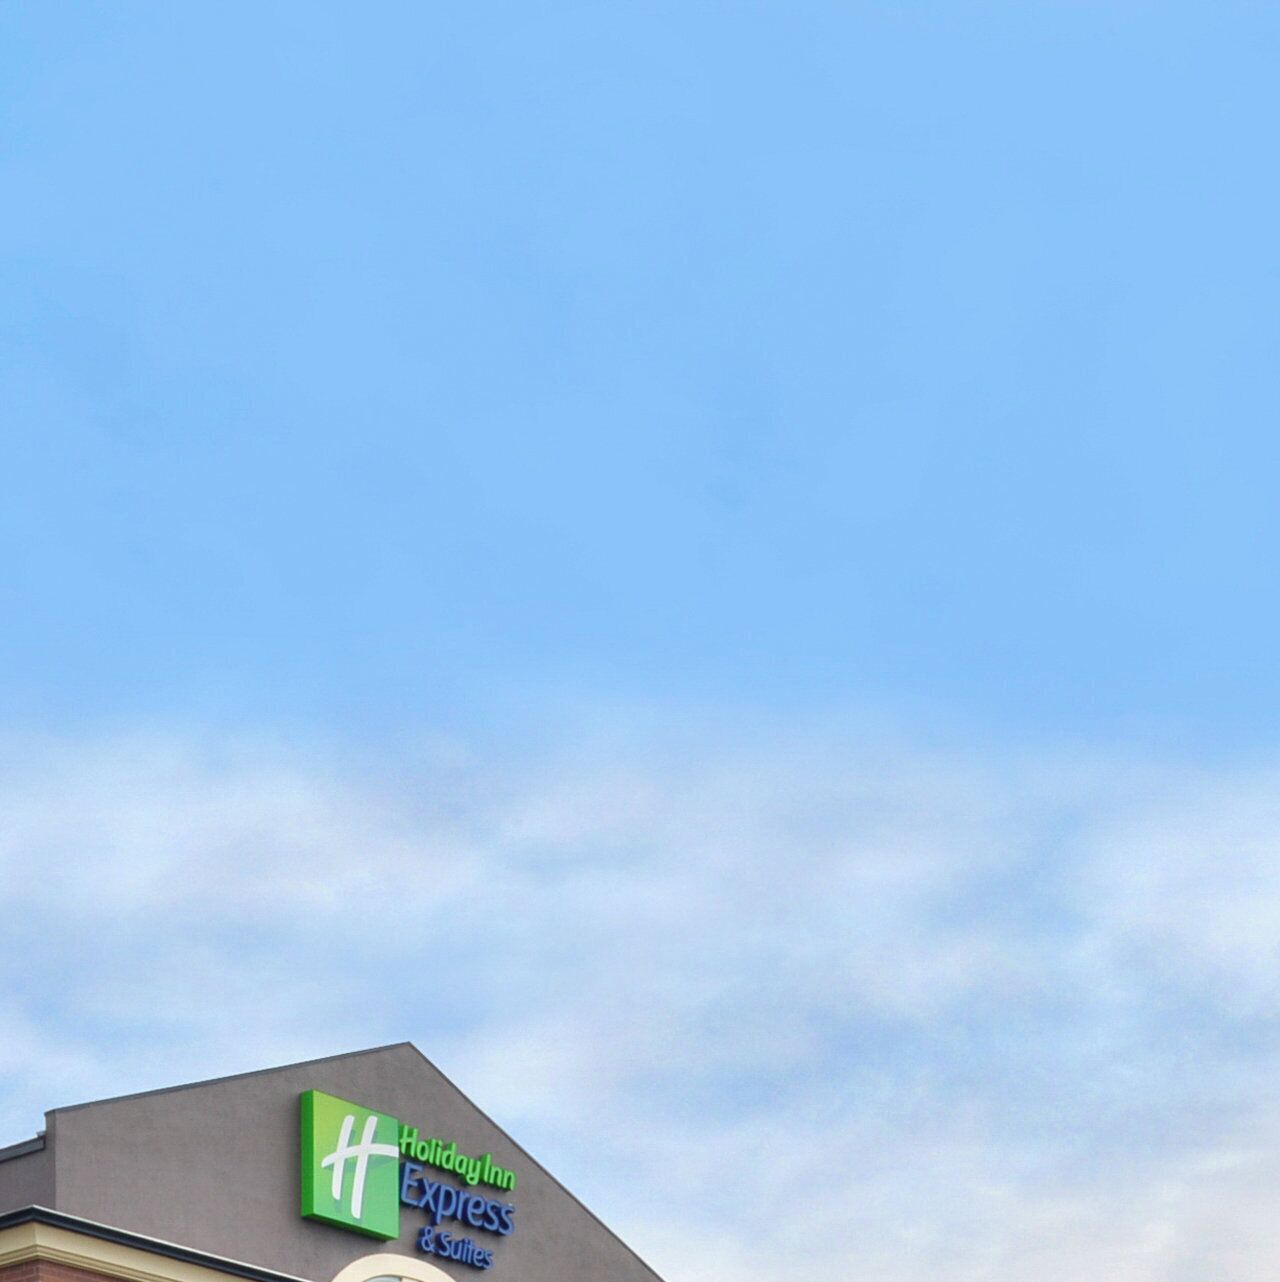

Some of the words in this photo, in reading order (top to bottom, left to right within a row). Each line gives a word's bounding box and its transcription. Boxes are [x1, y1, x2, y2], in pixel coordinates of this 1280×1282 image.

[399, 1124, 481, 1186] Holiday
[482, 1152, 516, 1191] Inn
[400, 1161, 515, 1236] Express
[418, 1225, 435, 1253] &
[436, 1231, 494, 1270] Suites
